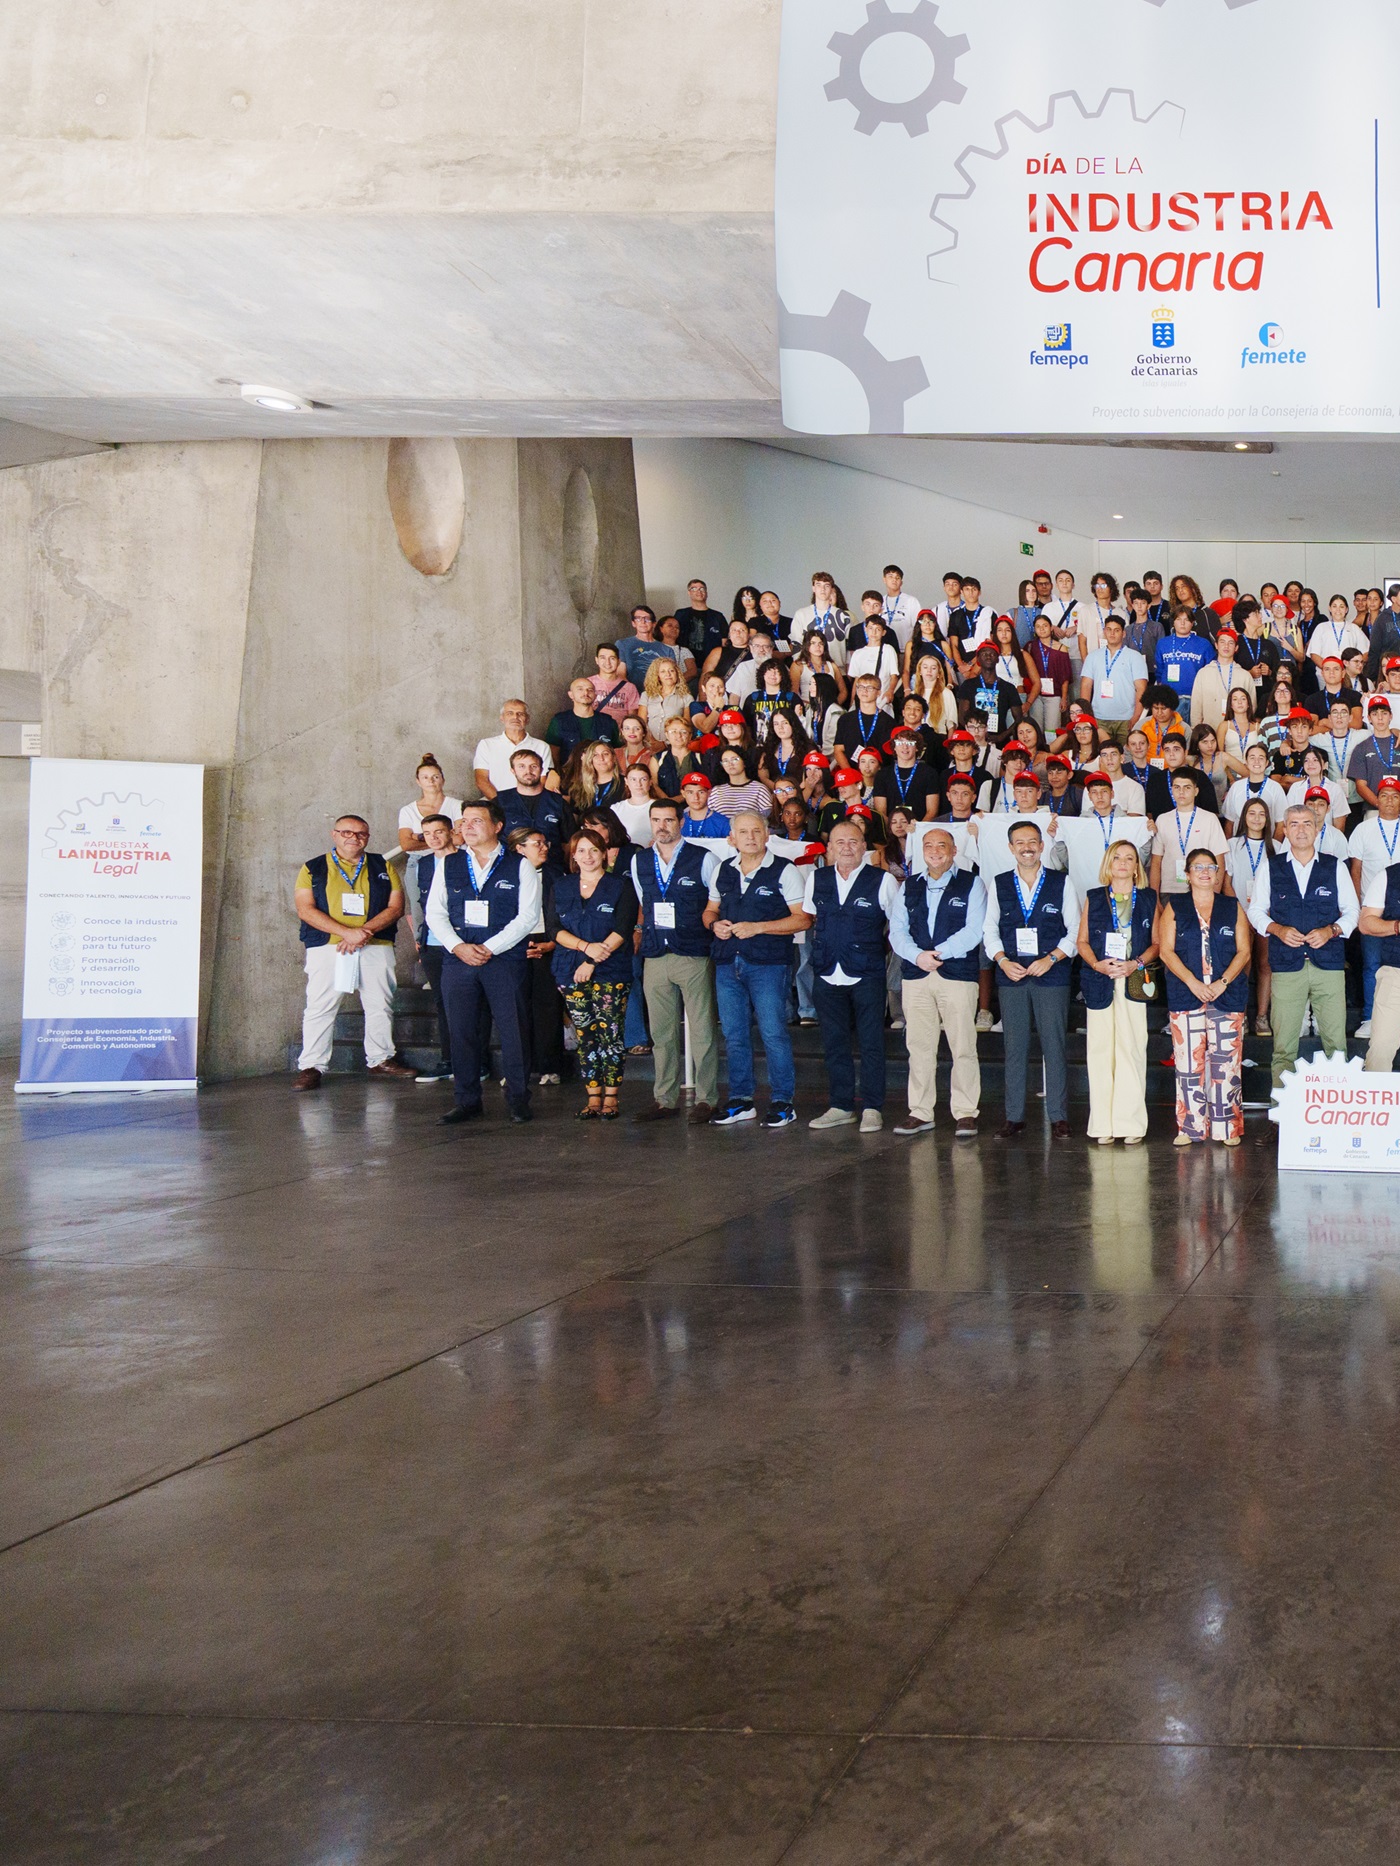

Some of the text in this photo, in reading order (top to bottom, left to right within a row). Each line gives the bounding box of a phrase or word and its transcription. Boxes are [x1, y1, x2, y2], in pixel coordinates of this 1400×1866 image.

[1026, 153, 1144, 175] DÍA DE LA
[1028, 191, 1334, 233] INDUSTRIA
[1028, 237, 1265, 293] Canaria
[1030, 351, 1089, 369] femepa
[1137, 354, 1192, 365] Gobierno
[1241, 347, 1307, 369] femete
[1131, 366, 1198, 376] de Canarias
[1092, 406, 1140, 419] Proyecto
[1143, 406, 1226, 417] subvencionado
[1228, 408, 1245, 419] por
[1249, 406, 1258, 416] la
[1261, 405, 1319, 419] Consejería
[1321, 405, 1335, 416] de
[84, 841, 149, 849] #APUESTAX
[58, 849, 172, 861] LAINDUSTRIA
[93, 861, 139, 877] Legal
[84, 917, 121, 925] Conoce
[82, 934, 157, 943] Oportunidades
[82, 956, 135, 964] Formación
[89, 987, 142, 995] tecnología
[46, 1028, 83, 1036] Proyecto
[149, 1028, 162, 1036] por
[1305, 1074, 1320, 1083] DÍA
[1337, 1076, 1348, 1084] LA
[1304, 1105, 1390, 1126] Canaria
